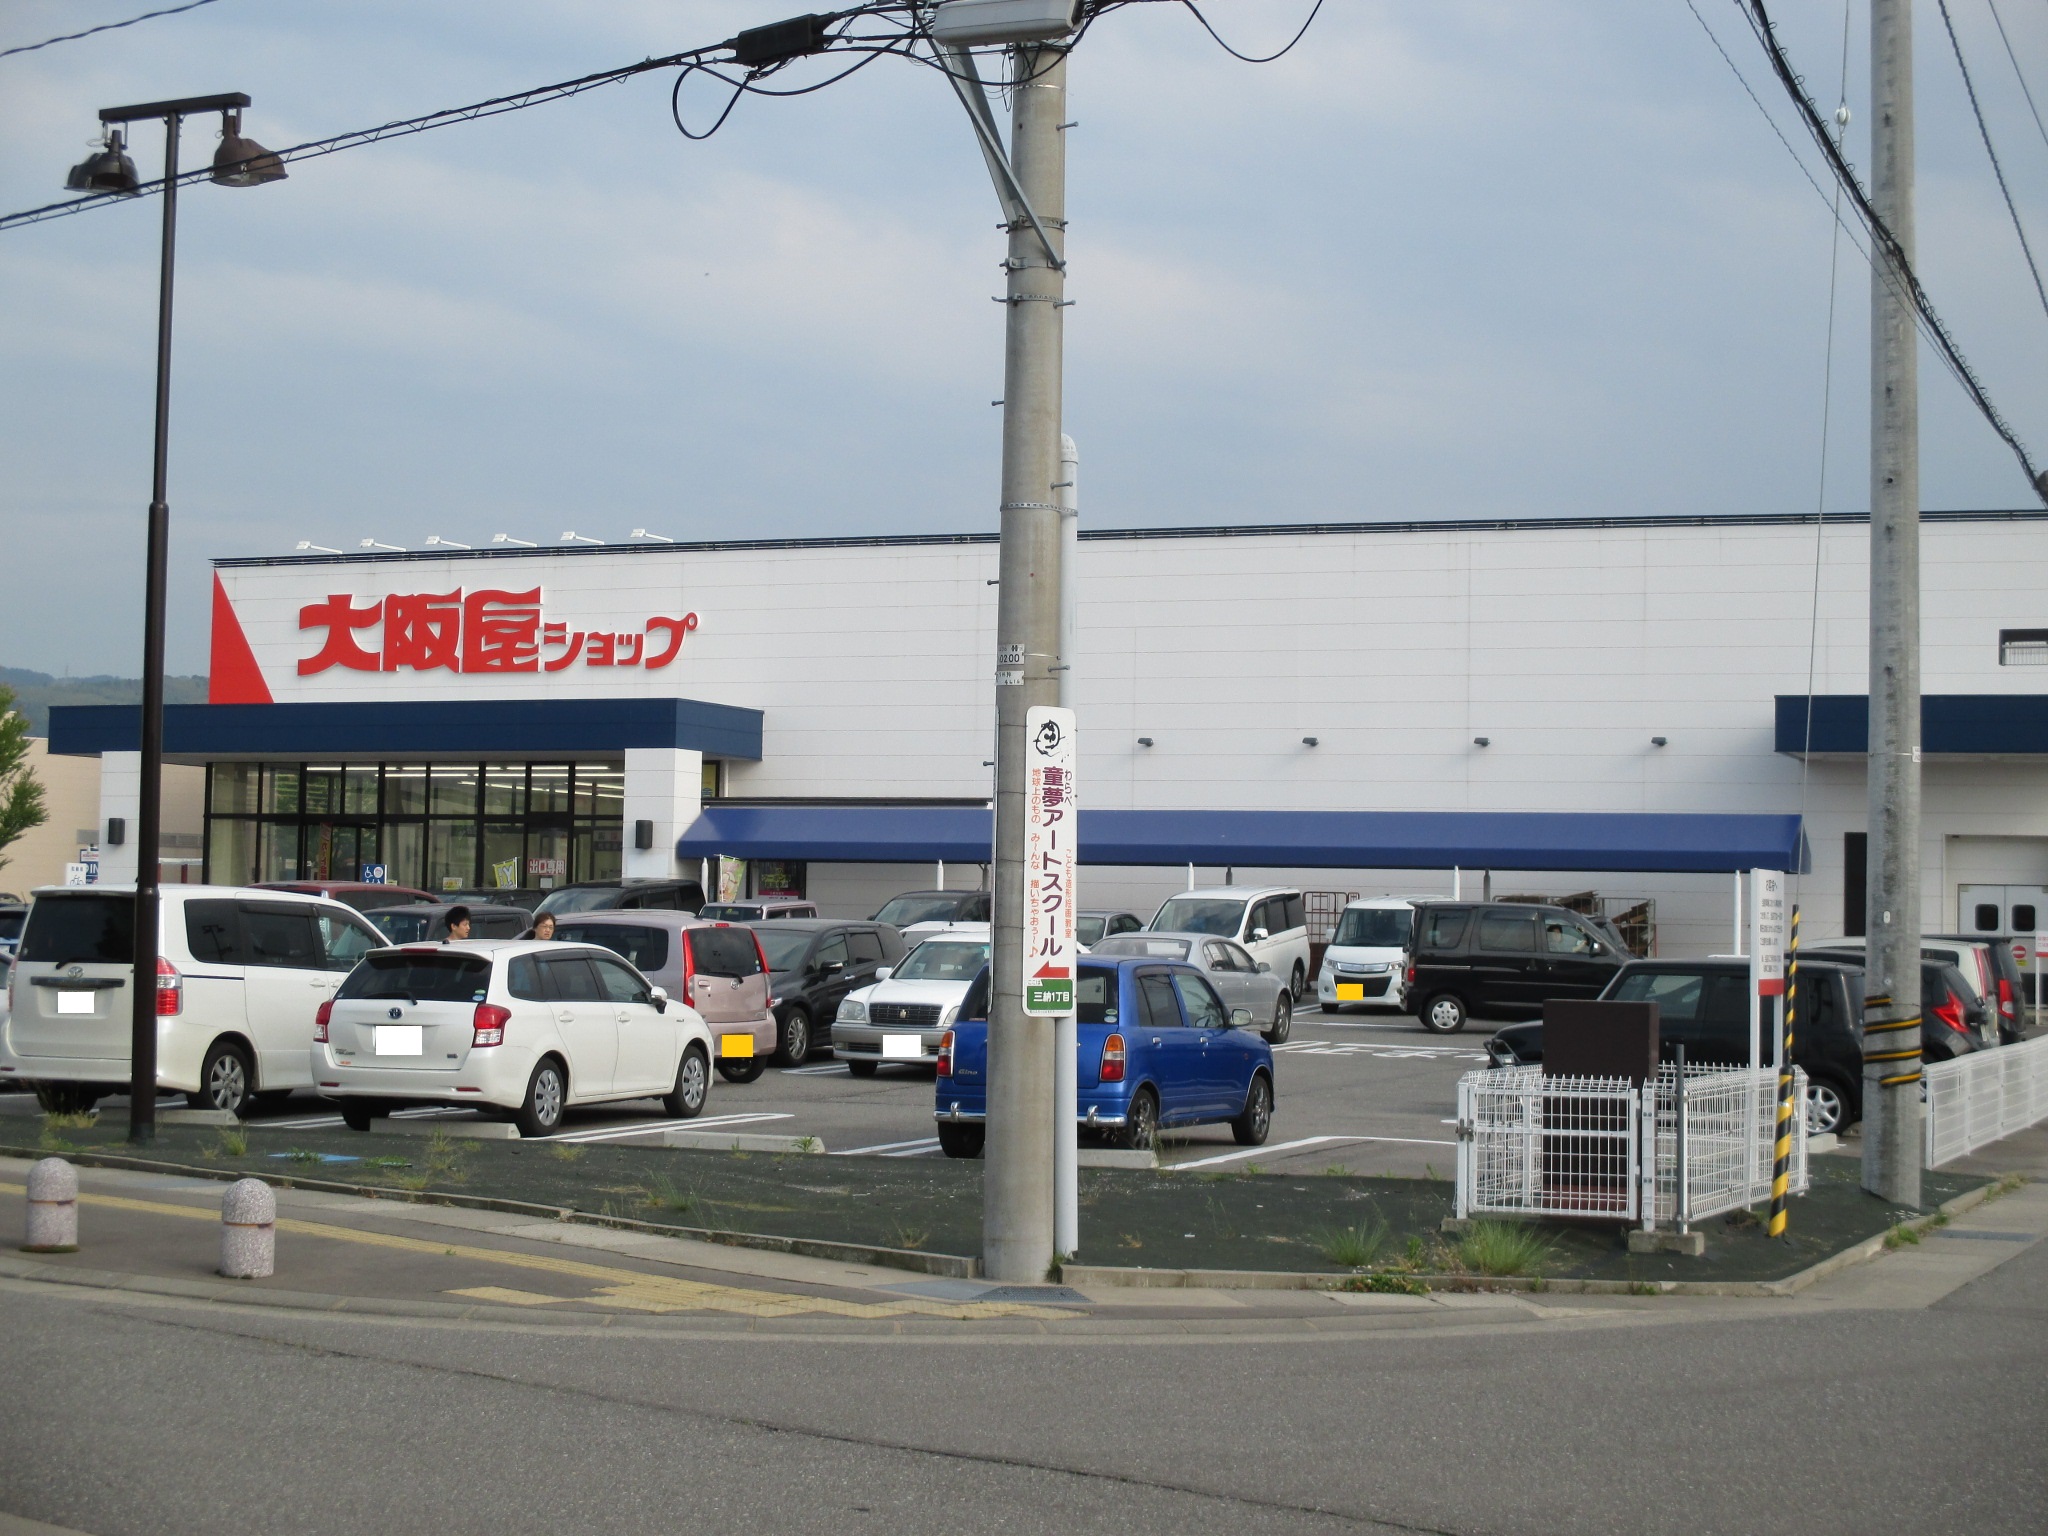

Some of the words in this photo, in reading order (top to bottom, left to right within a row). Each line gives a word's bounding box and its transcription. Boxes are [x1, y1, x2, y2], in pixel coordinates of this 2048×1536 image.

[297, 585, 701, 677] 大阪屋ショップ
[999, 653, 1020, 663] 0200
[1031, 768, 1042, 824] 地球上のもの
[1064, 769, 1073, 807] わらべ
[529, 859, 565, 875] 出口専用
[1039, 766, 1064, 957] 童夢アートスクール
[1064, 848, 1073, 939] こども造形絵画教室
[1033, 991, 1070, 1003] 三納1丁目
